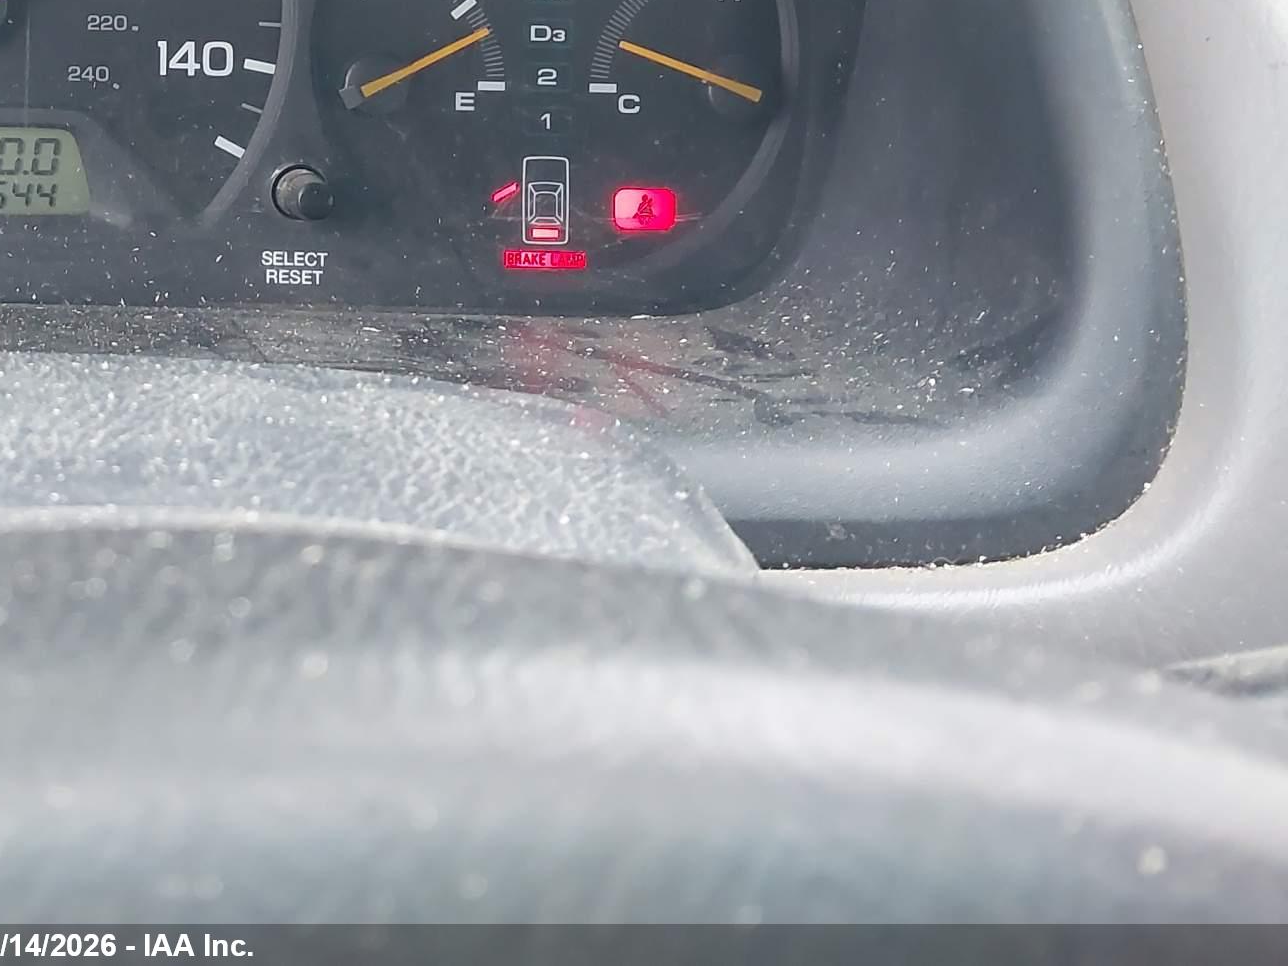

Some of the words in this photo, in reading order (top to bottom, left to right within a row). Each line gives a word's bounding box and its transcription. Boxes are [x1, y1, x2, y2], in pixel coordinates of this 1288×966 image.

[87, 15, 127, 31] 220
[530, 25, 566, 42] D3
[157, 41, 233, 76] 140
[68, 66, 109, 82] 240
[537, 69, 557, 86] 2
[455, 92, 475, 111] E
[618, 95, 641, 114] C
[541, 113, 551, 130] 1
[261, 251, 328, 267] SELECT
[507, 252, 546, 266] BRAKE
[266, 270, 324, 285] RESET
